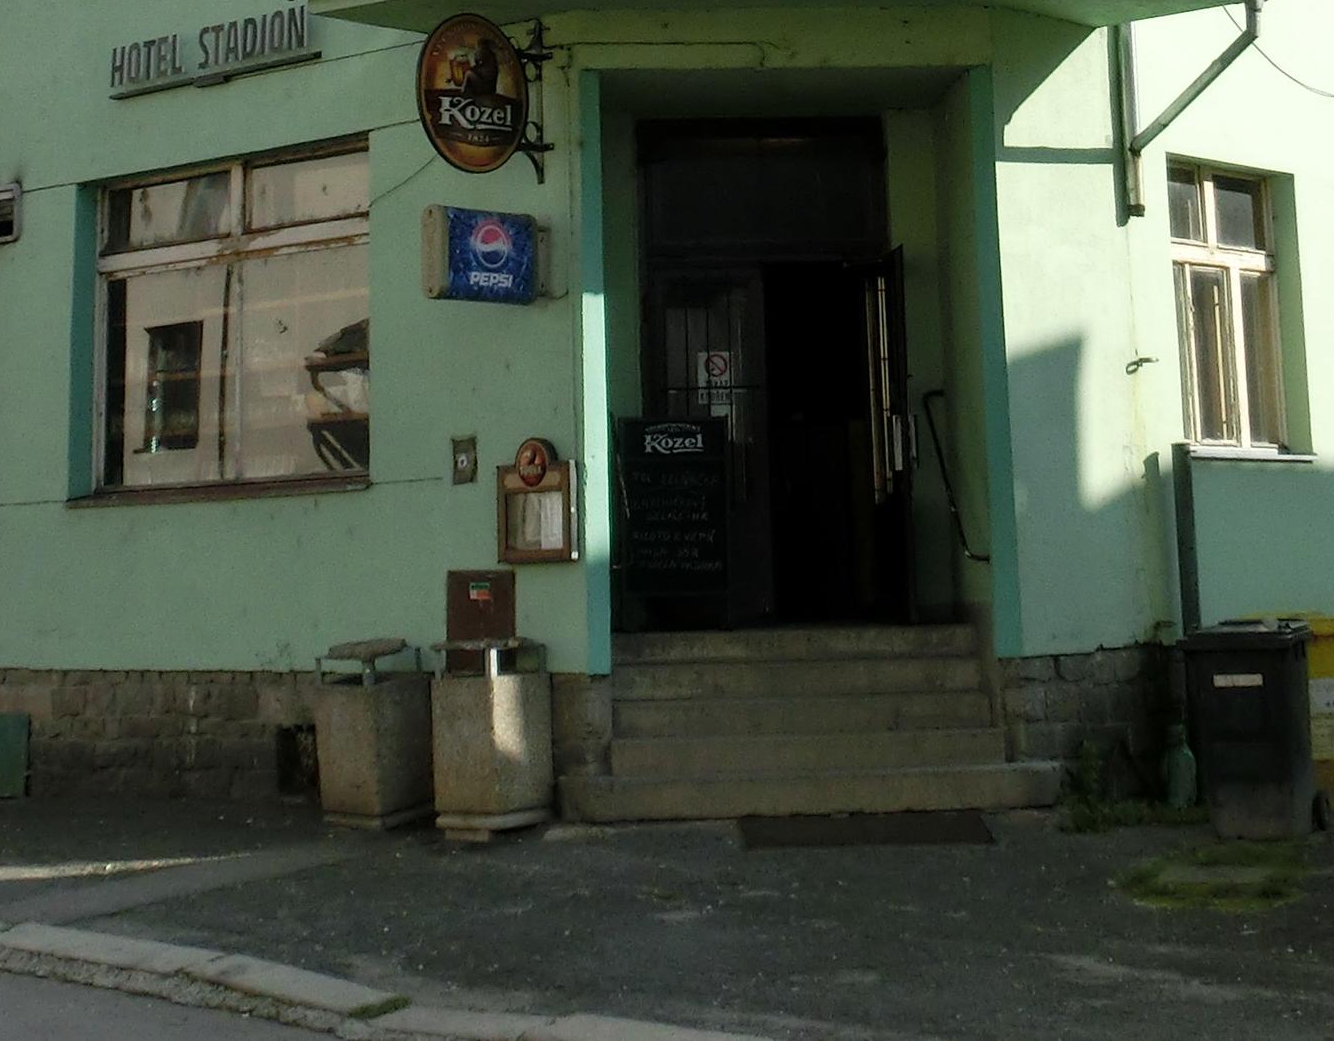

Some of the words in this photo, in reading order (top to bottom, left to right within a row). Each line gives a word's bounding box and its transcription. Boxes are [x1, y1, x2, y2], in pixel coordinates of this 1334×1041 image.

[110, 33, 184, 88] HOTEL
[198, 5, 309, 70] STADION
[438, 96, 513, 131] Kozel
[470, 271, 514, 288] PEPSI
[643, 433, 705, 454] Kozel
